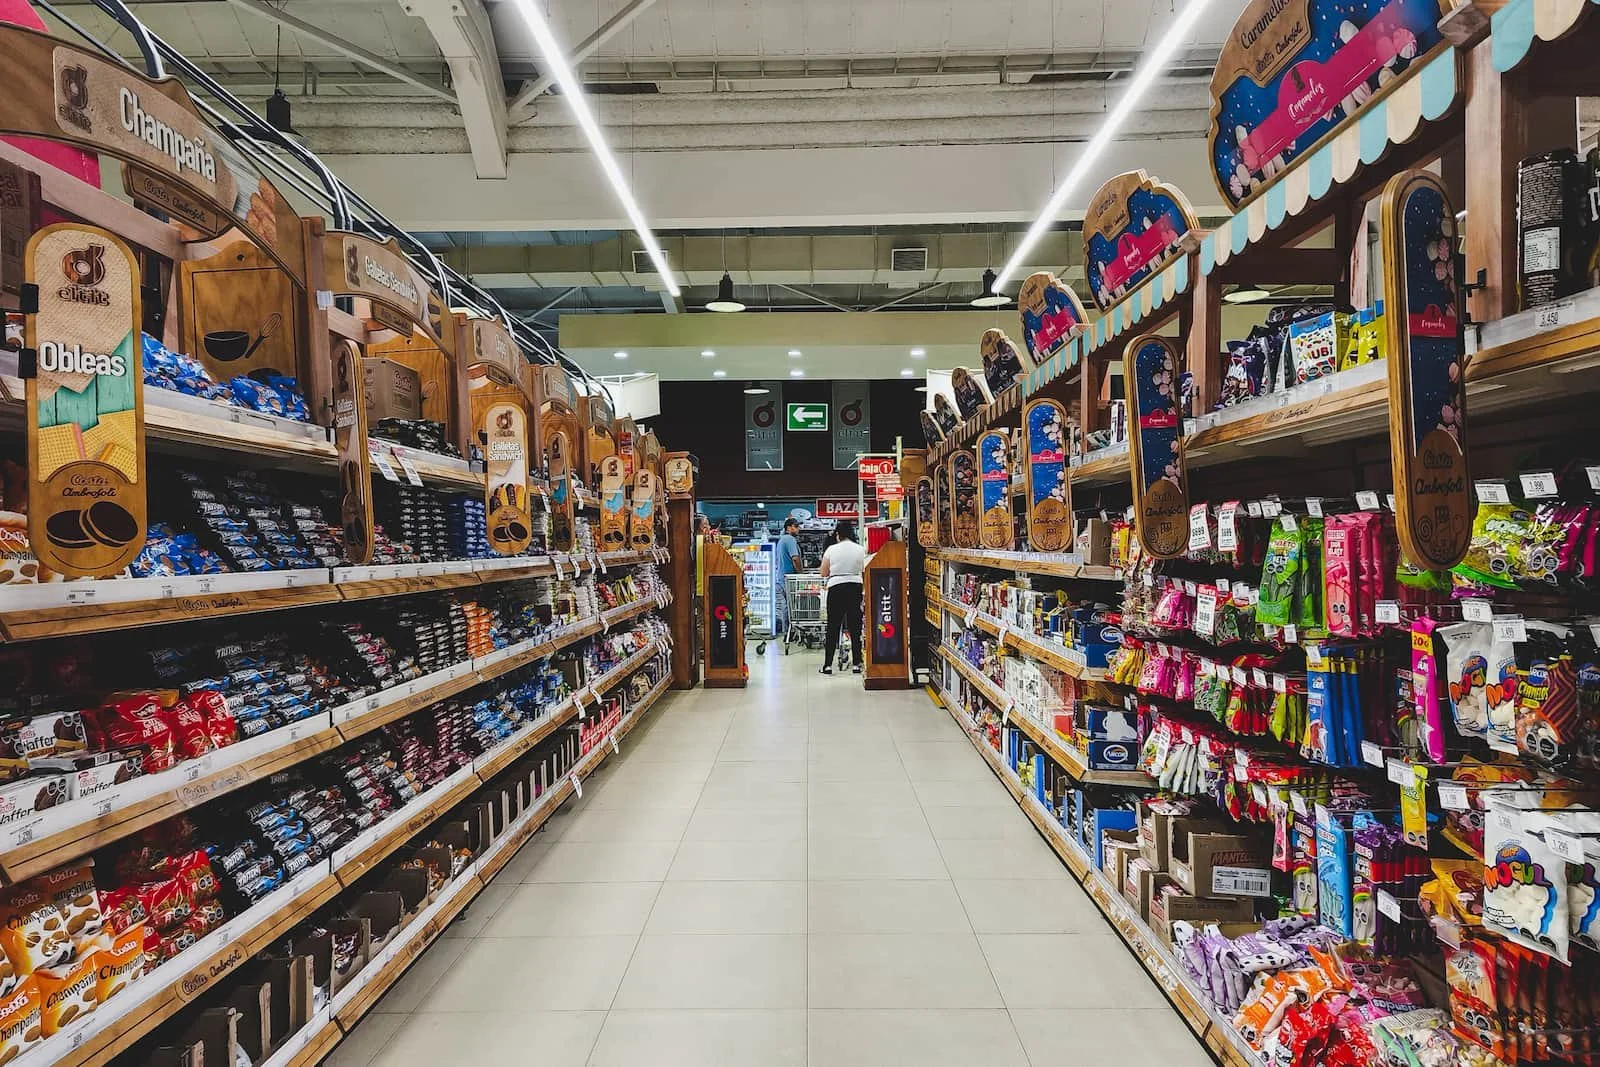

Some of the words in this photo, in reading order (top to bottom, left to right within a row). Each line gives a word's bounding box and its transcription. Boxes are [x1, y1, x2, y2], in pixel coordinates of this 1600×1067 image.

[119, 87, 217, 184] Champaña
[39, 341, 127, 377] Obleas
[859, 463, 879, 475] Caja
[825, 502, 869, 514] BAZAR
[1483, 860, 1553, 893] MOGUL
